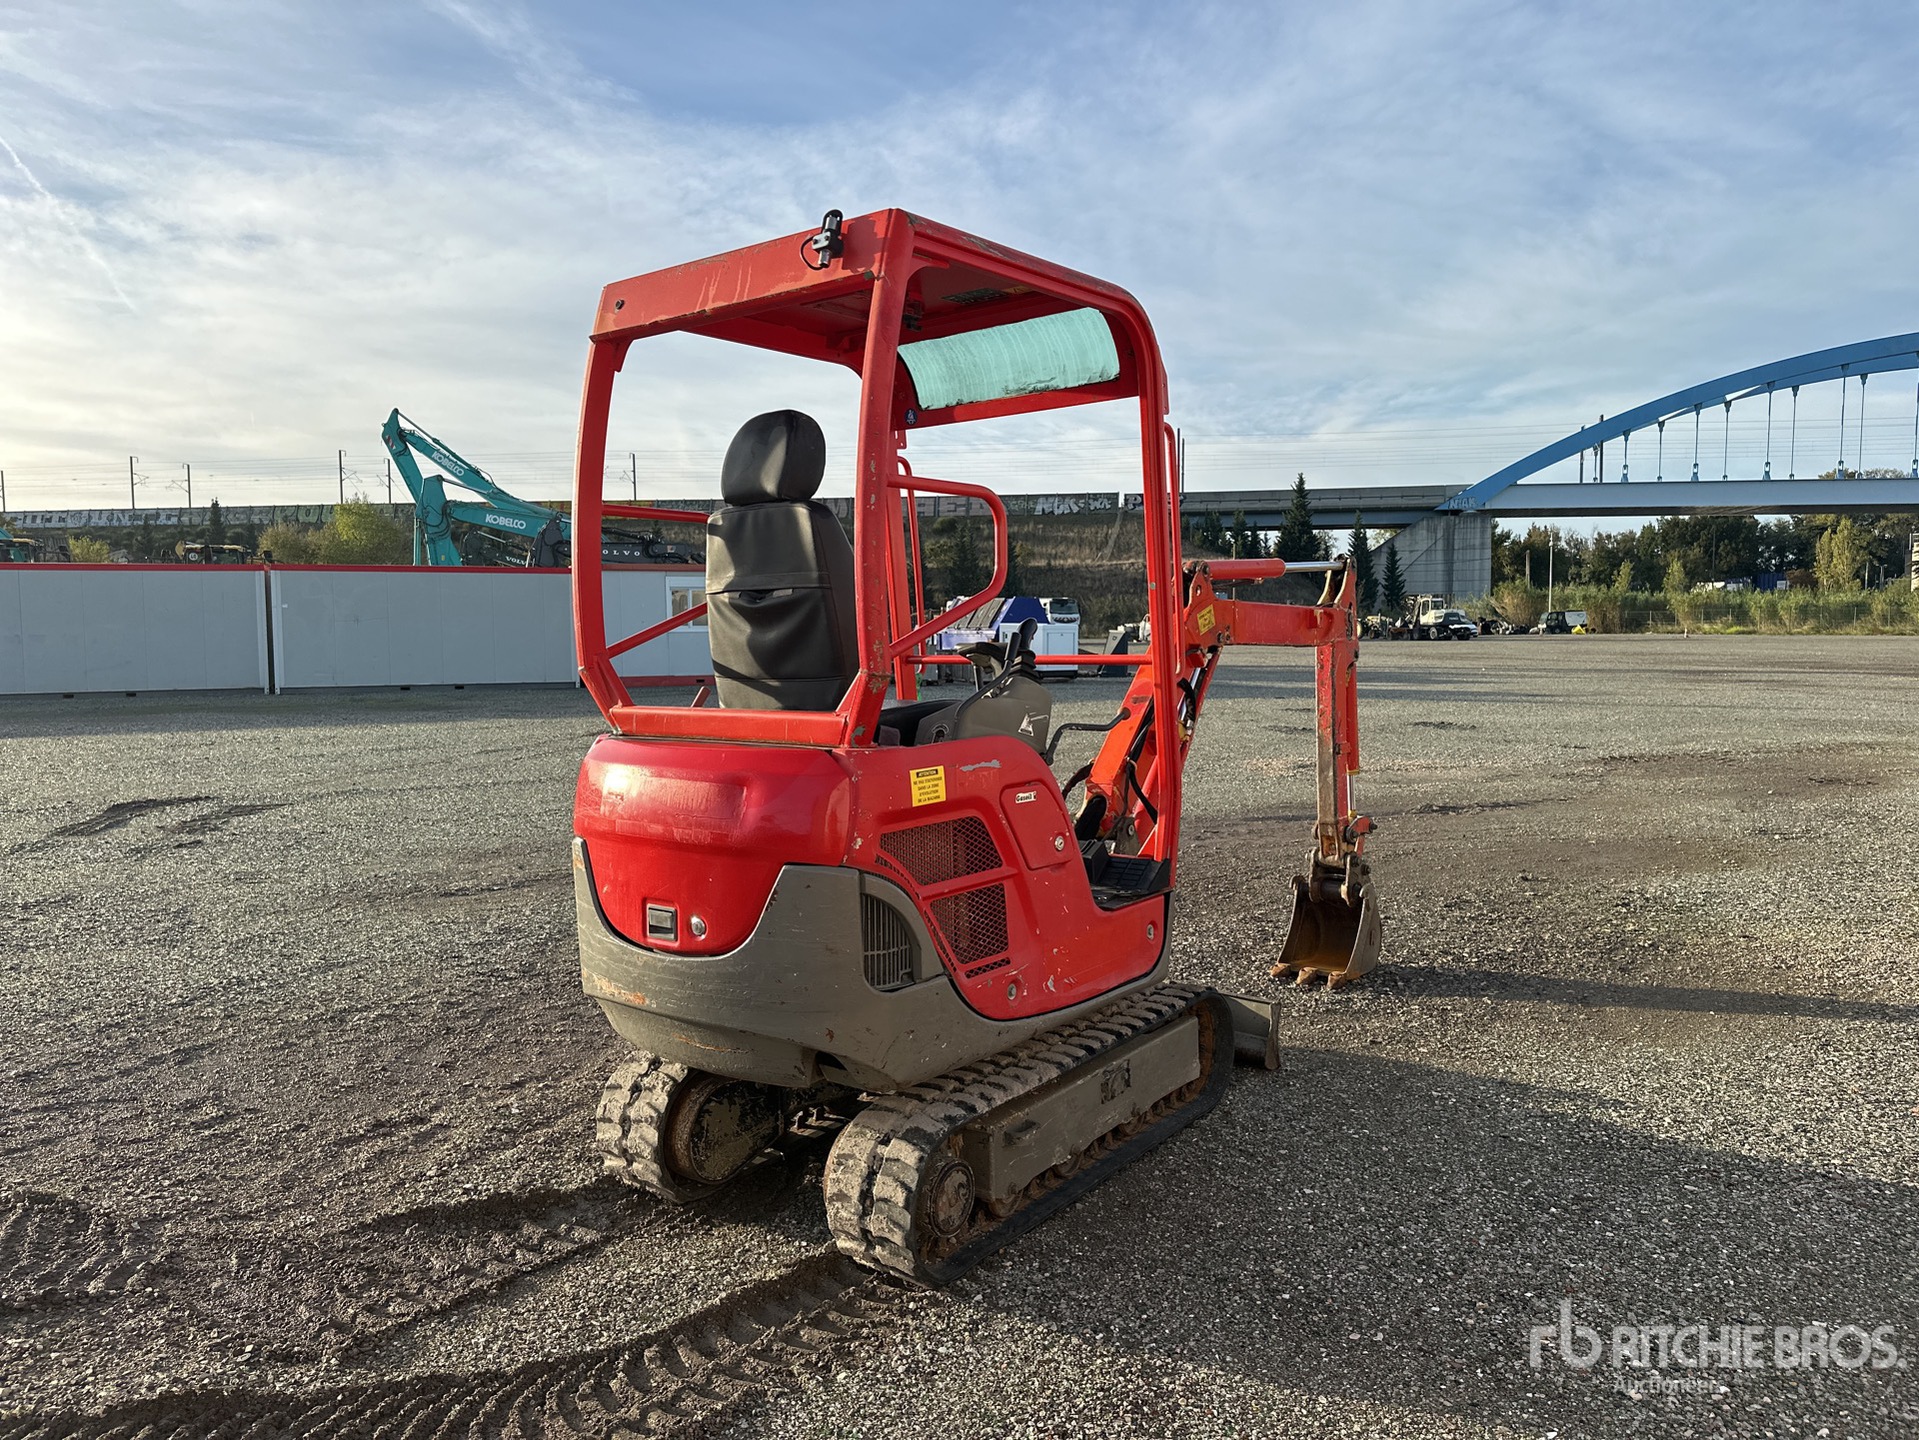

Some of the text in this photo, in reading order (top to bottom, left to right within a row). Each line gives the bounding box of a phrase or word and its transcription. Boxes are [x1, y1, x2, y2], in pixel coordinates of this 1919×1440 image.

[431, 451, 465, 477] KOBELCO
[485, 513, 527, 530] KOBELCO
[602, 549, 640, 557] OLVO
[505, 556, 528, 566] VOLV
